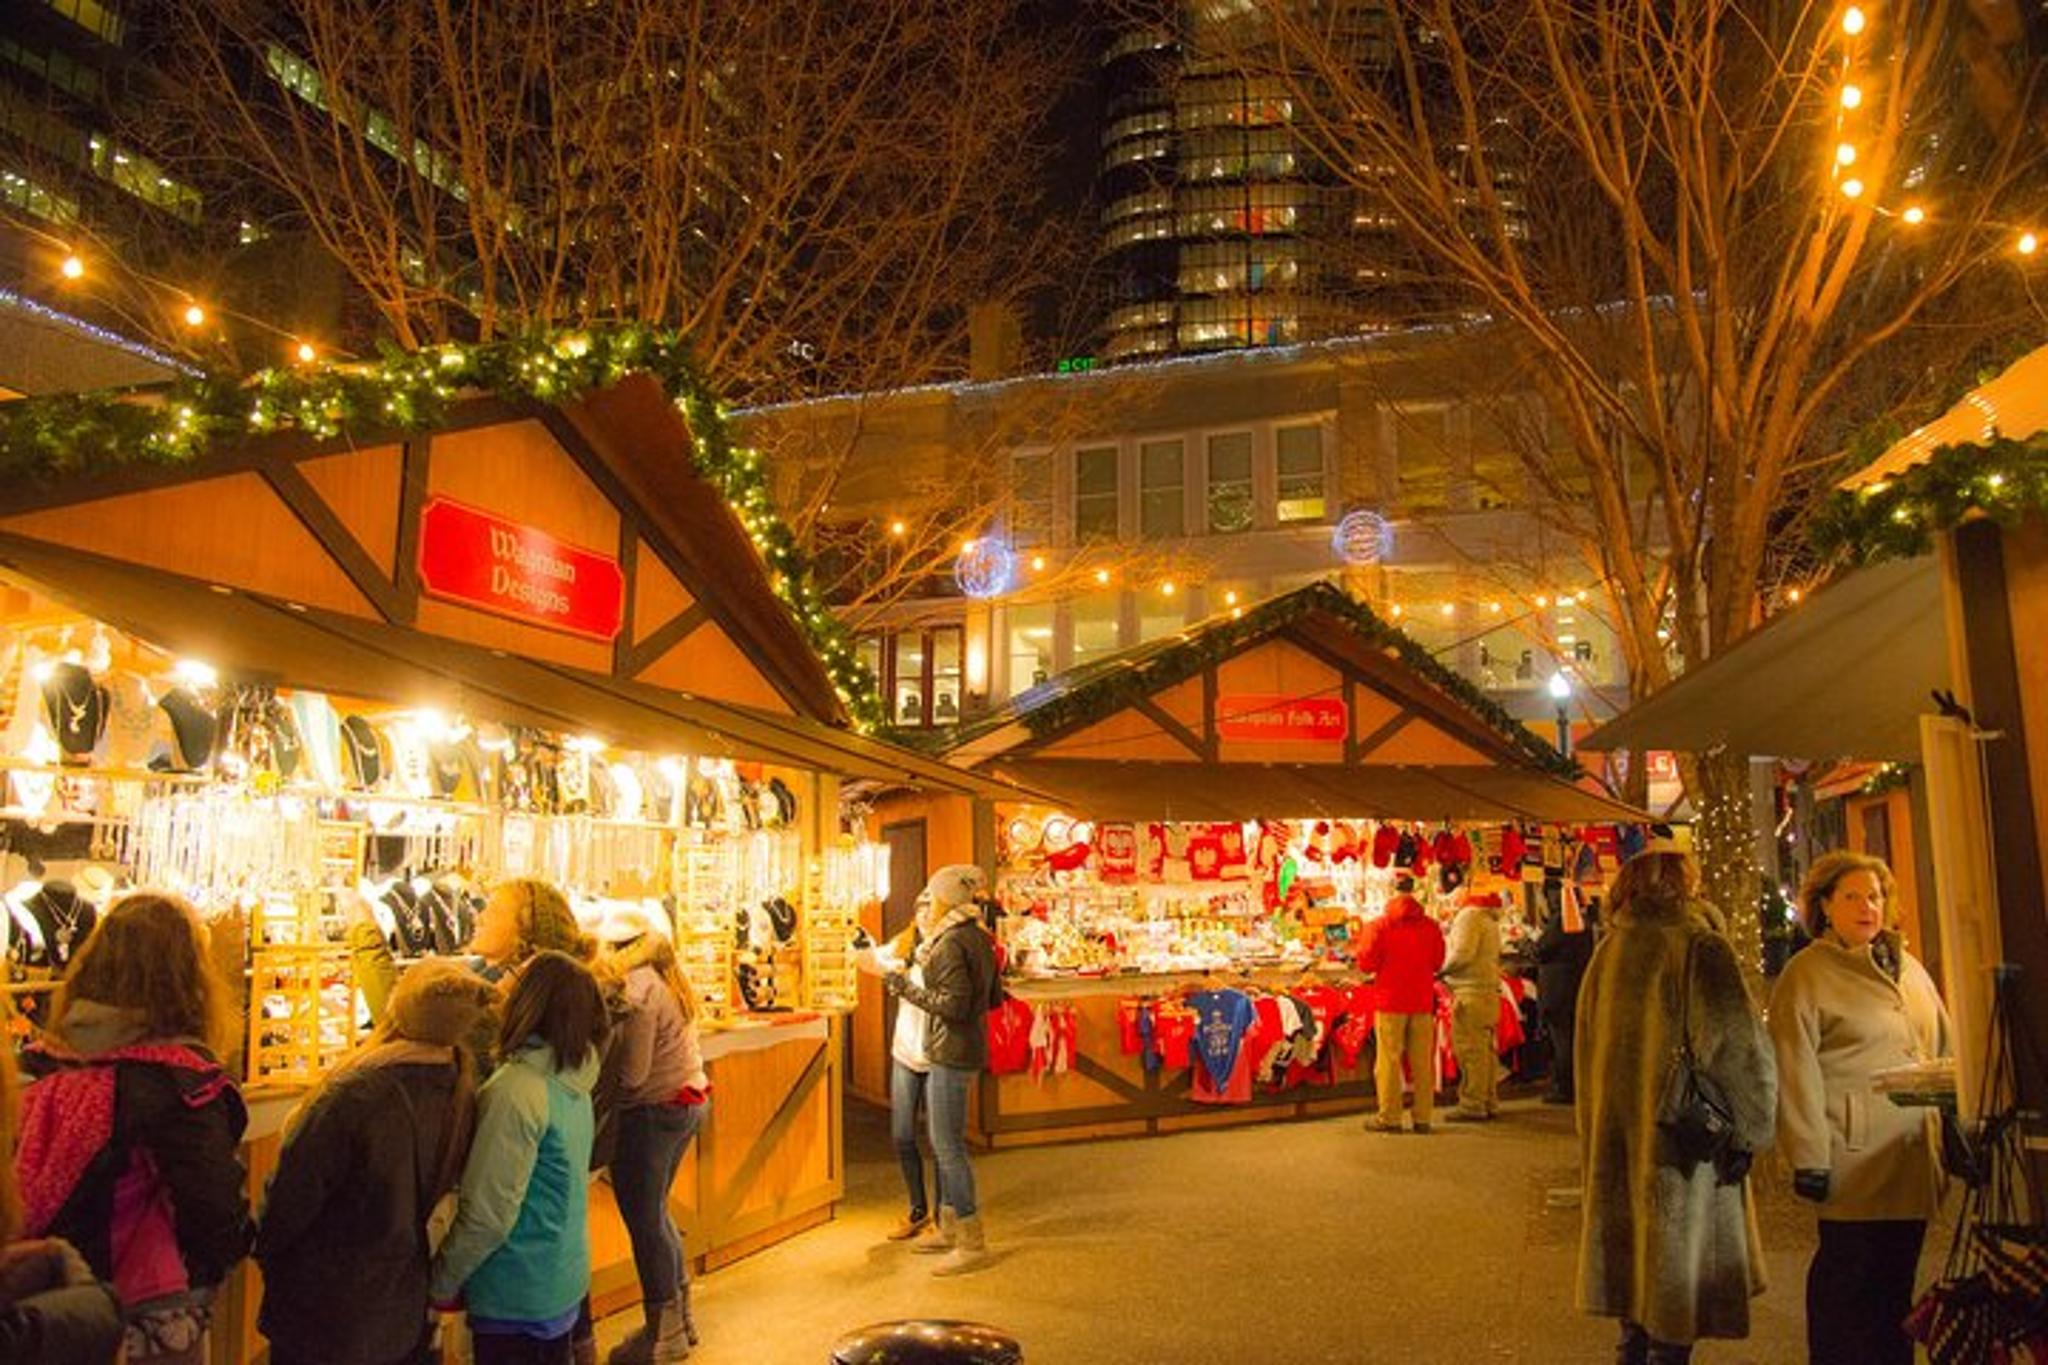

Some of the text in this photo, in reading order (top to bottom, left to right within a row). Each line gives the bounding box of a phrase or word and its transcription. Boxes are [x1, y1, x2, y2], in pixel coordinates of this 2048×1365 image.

[491, 566, 570, 615] Designs
[1287, 710, 1315, 726] Folk
[1317, 710, 1341, 726] Art
